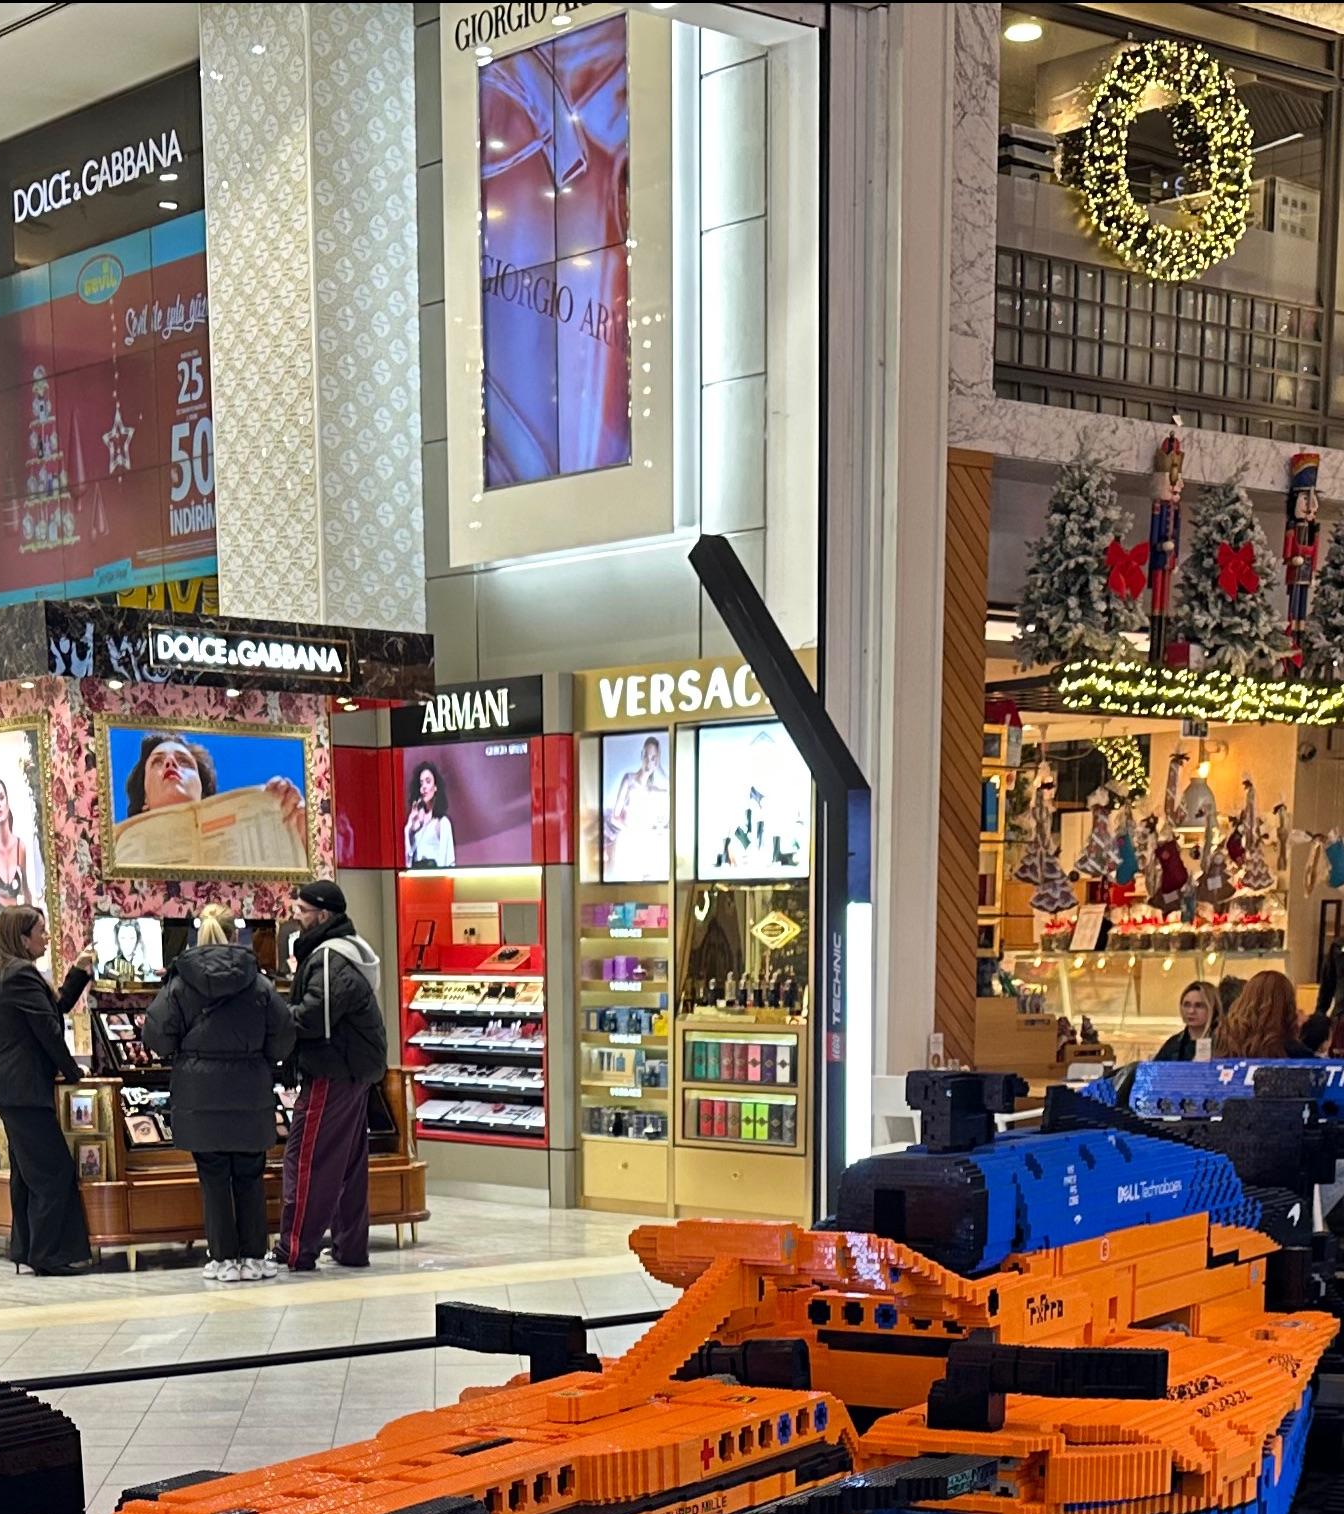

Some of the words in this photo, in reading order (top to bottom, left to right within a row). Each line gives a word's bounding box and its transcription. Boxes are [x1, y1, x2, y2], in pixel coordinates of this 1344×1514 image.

[421, 687, 510, 734] ARMANI
[599, 663, 771, 719] VERSAC
[832, 932, 843, 1026] TECHNIC
[701, 1495, 727, 1514] MILLE
